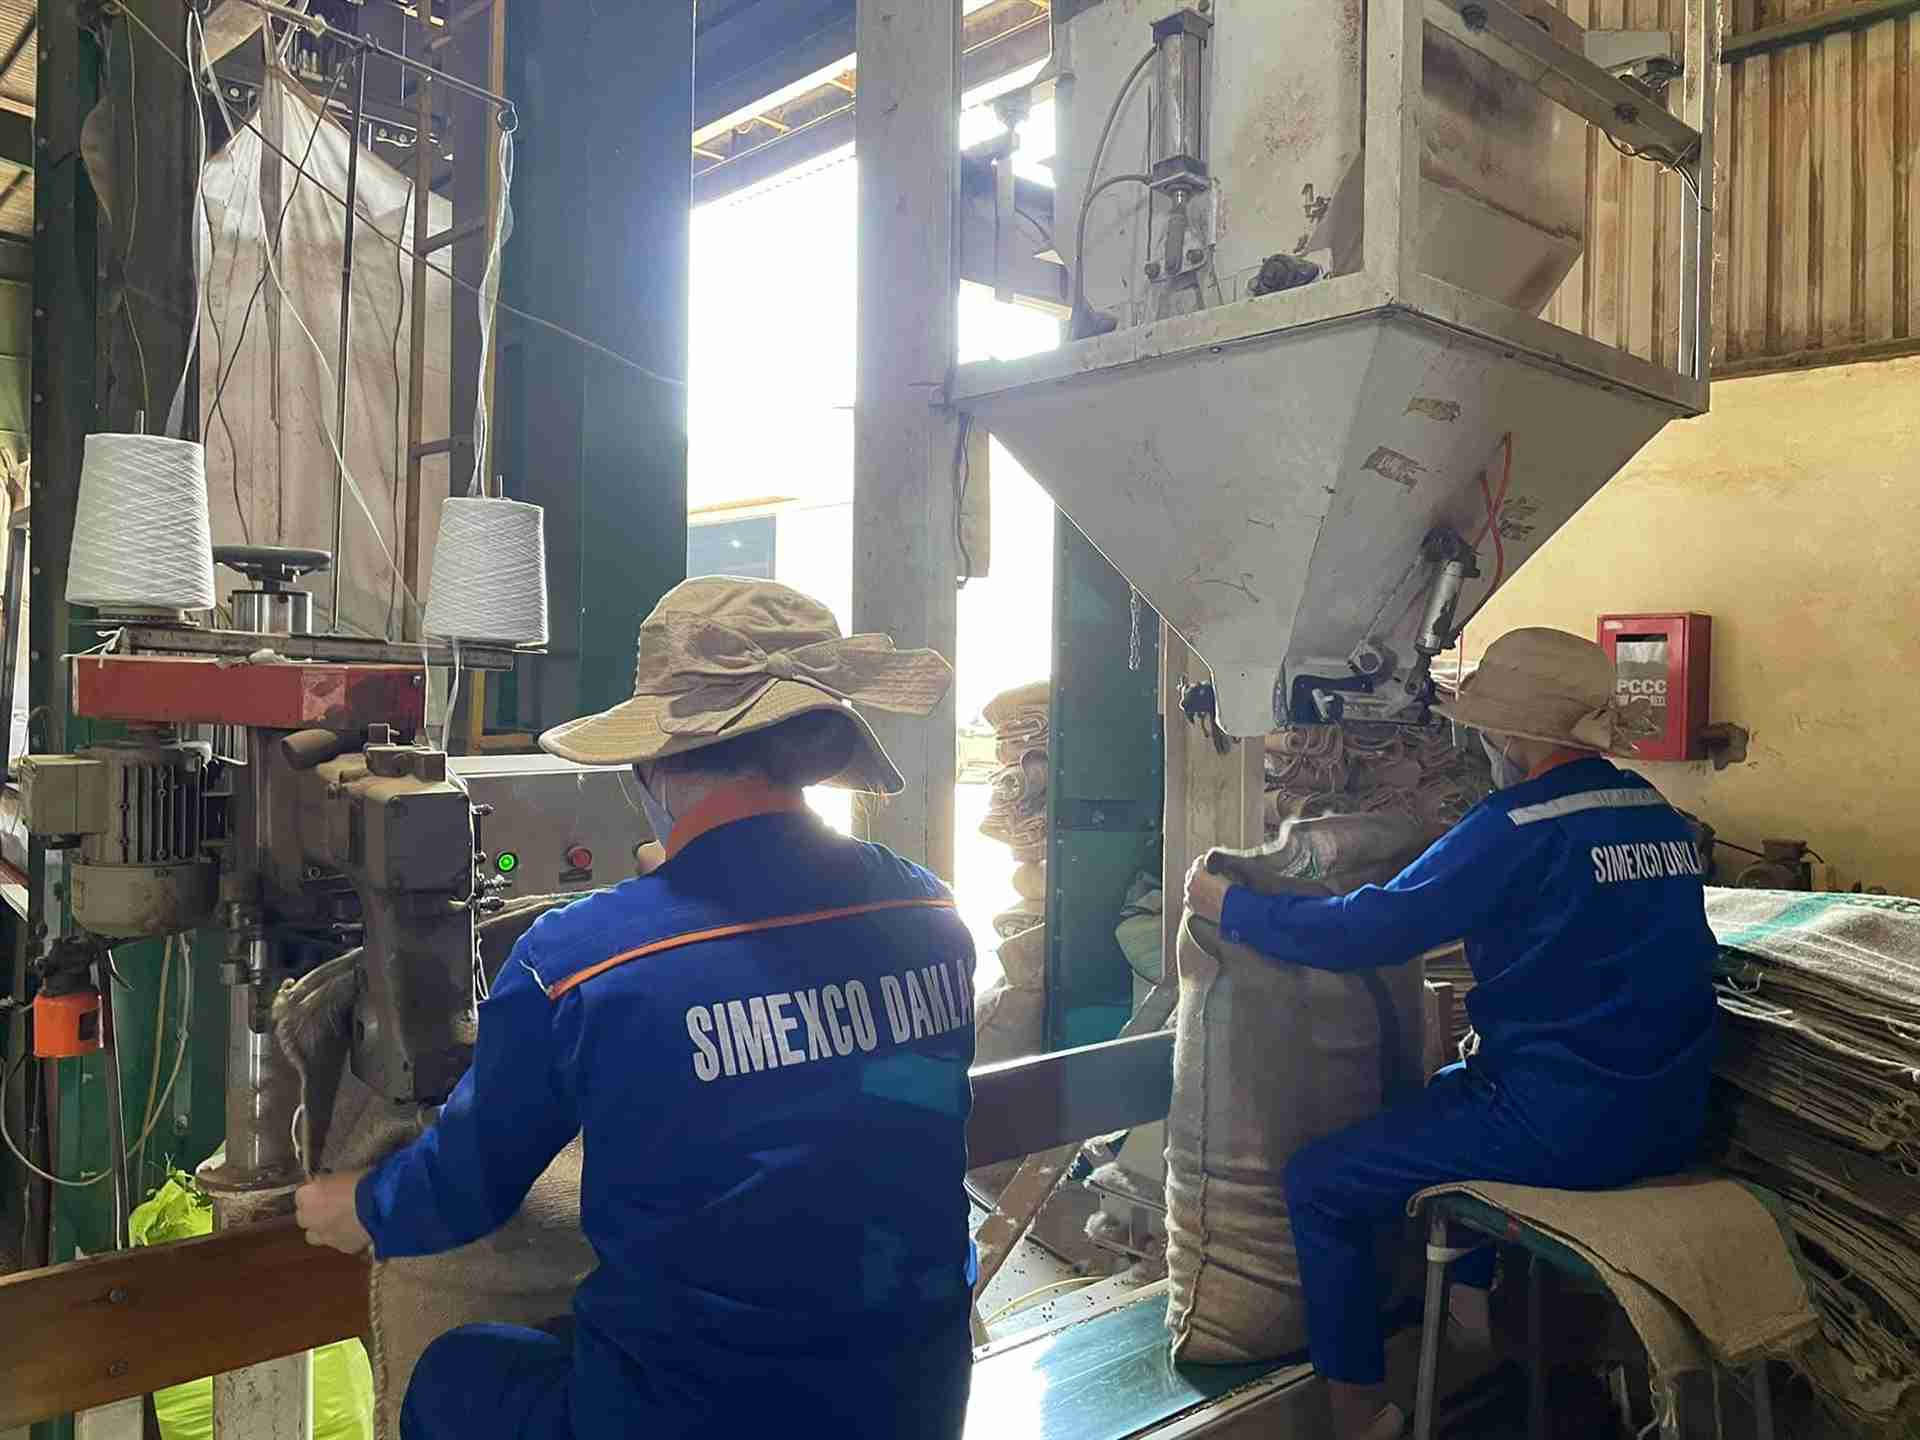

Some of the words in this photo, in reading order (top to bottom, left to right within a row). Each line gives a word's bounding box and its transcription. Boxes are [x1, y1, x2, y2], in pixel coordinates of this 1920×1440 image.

[1616, 679, 1667, 694] PCCC
[1591, 842, 1664, 883] SIMEXCO
[685, 979, 878, 1082] SIMEXCO
